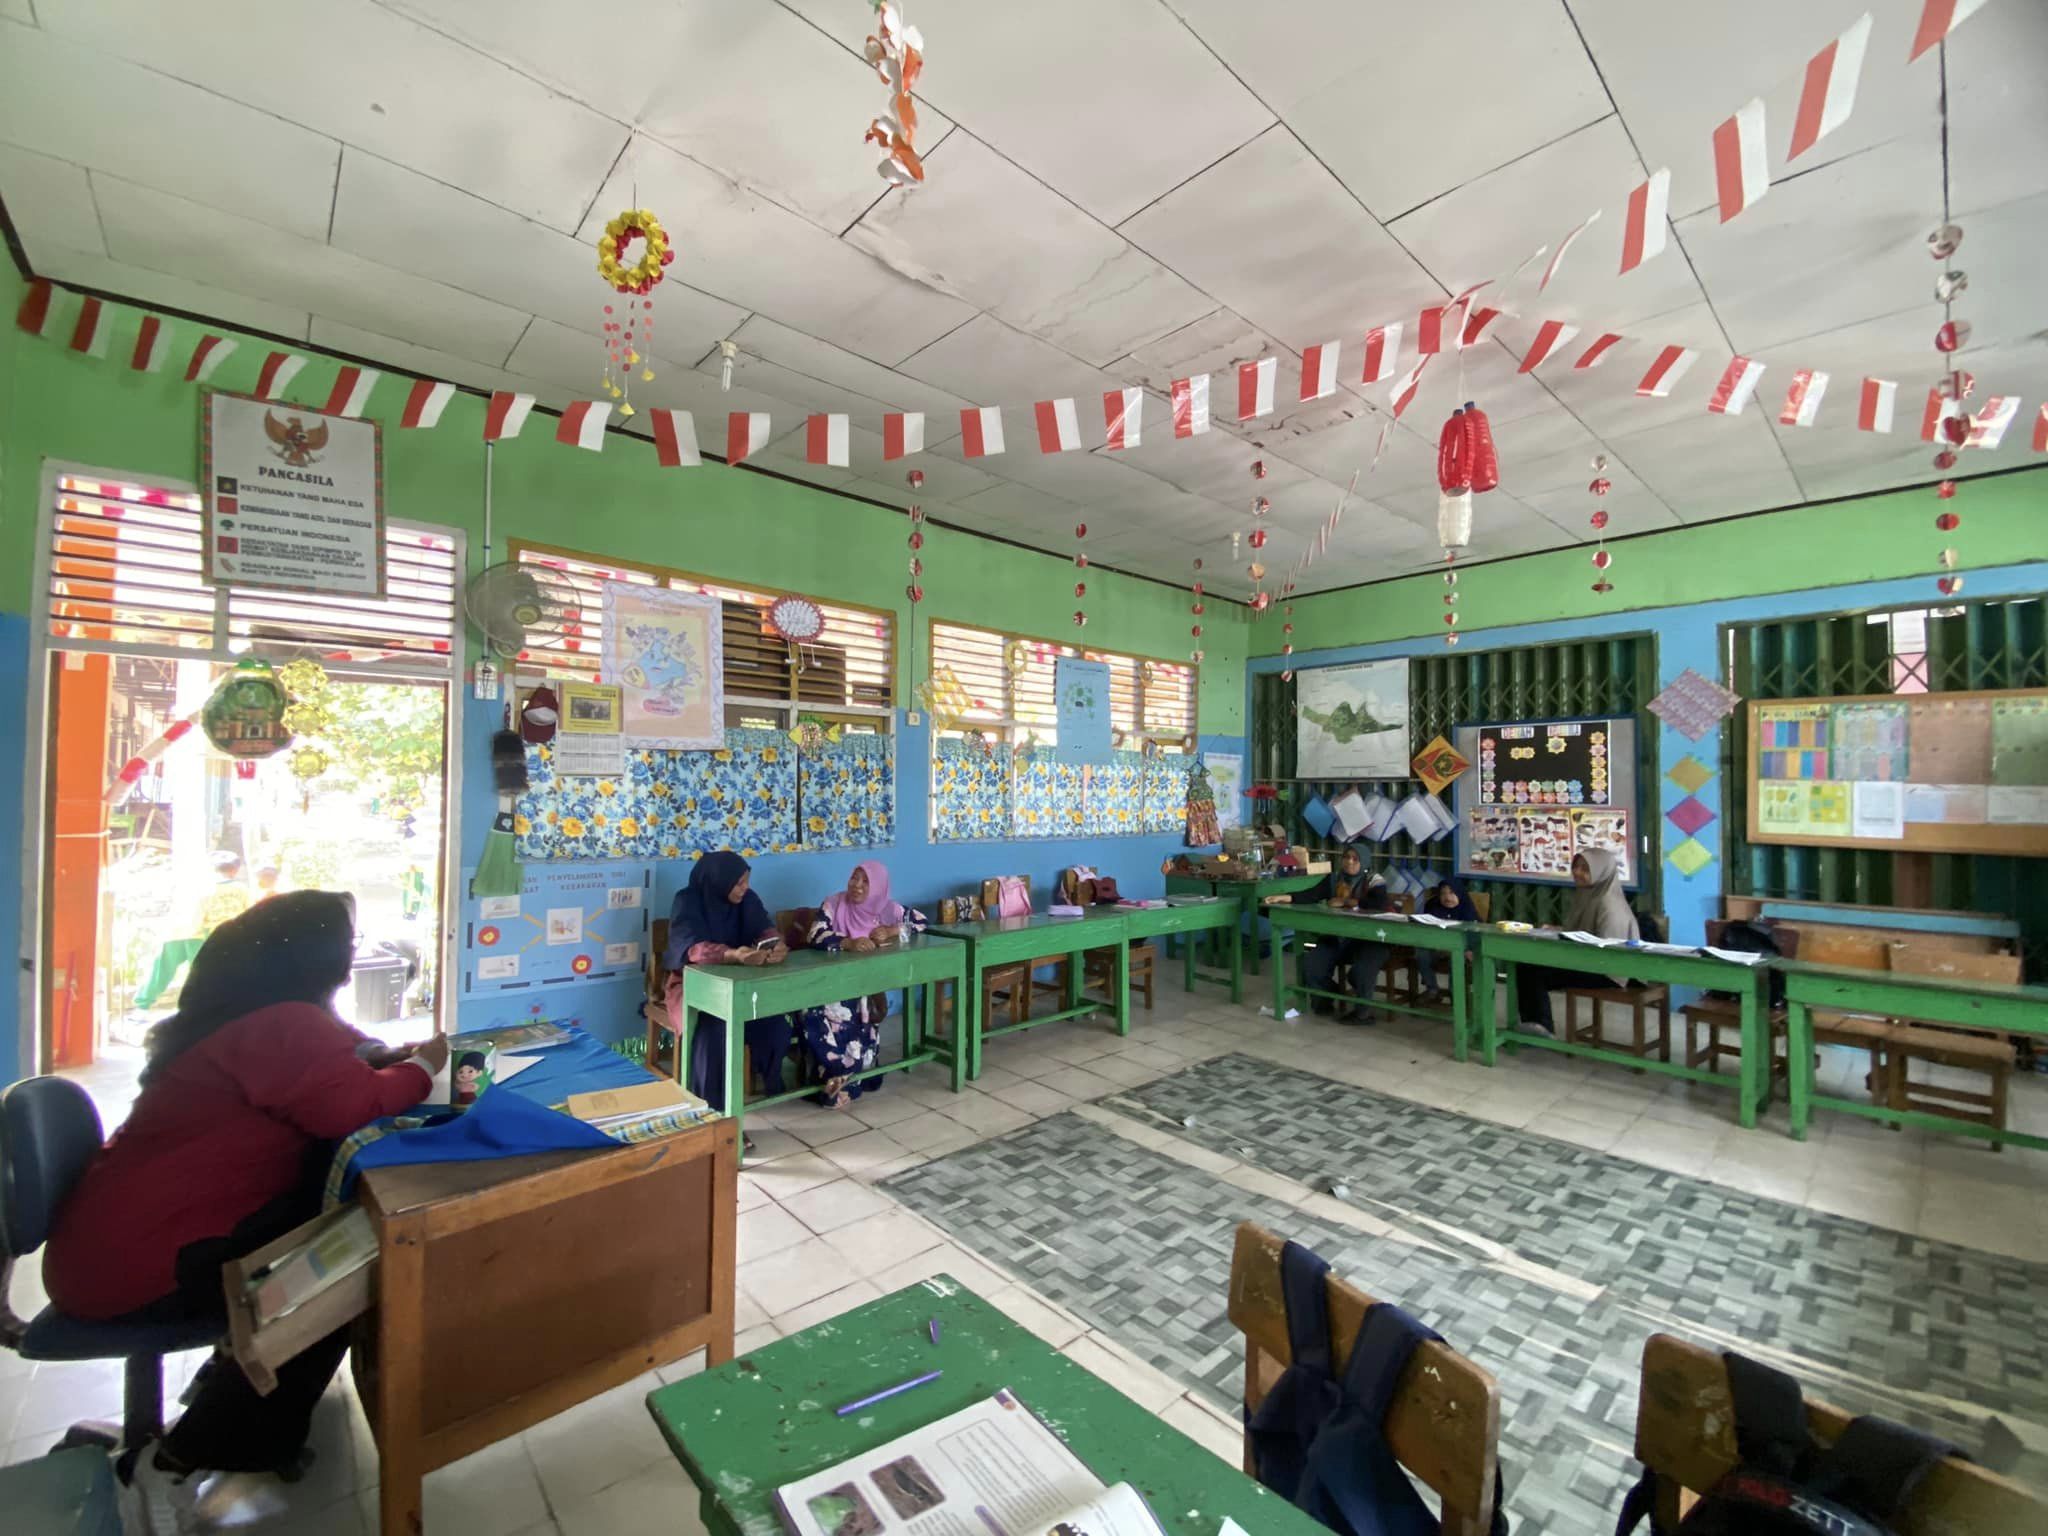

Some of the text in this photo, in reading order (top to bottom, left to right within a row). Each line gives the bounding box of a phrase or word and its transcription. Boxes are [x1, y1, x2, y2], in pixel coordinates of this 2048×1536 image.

[258, 466, 334, 487] PANCASILA
[240, 483, 295, 498] KETUHANAN
[321, 495, 346, 507] MAHA
[348, 500, 364, 508] ESA
[240, 522, 351, 543] PERSATUAN INDONESIA
